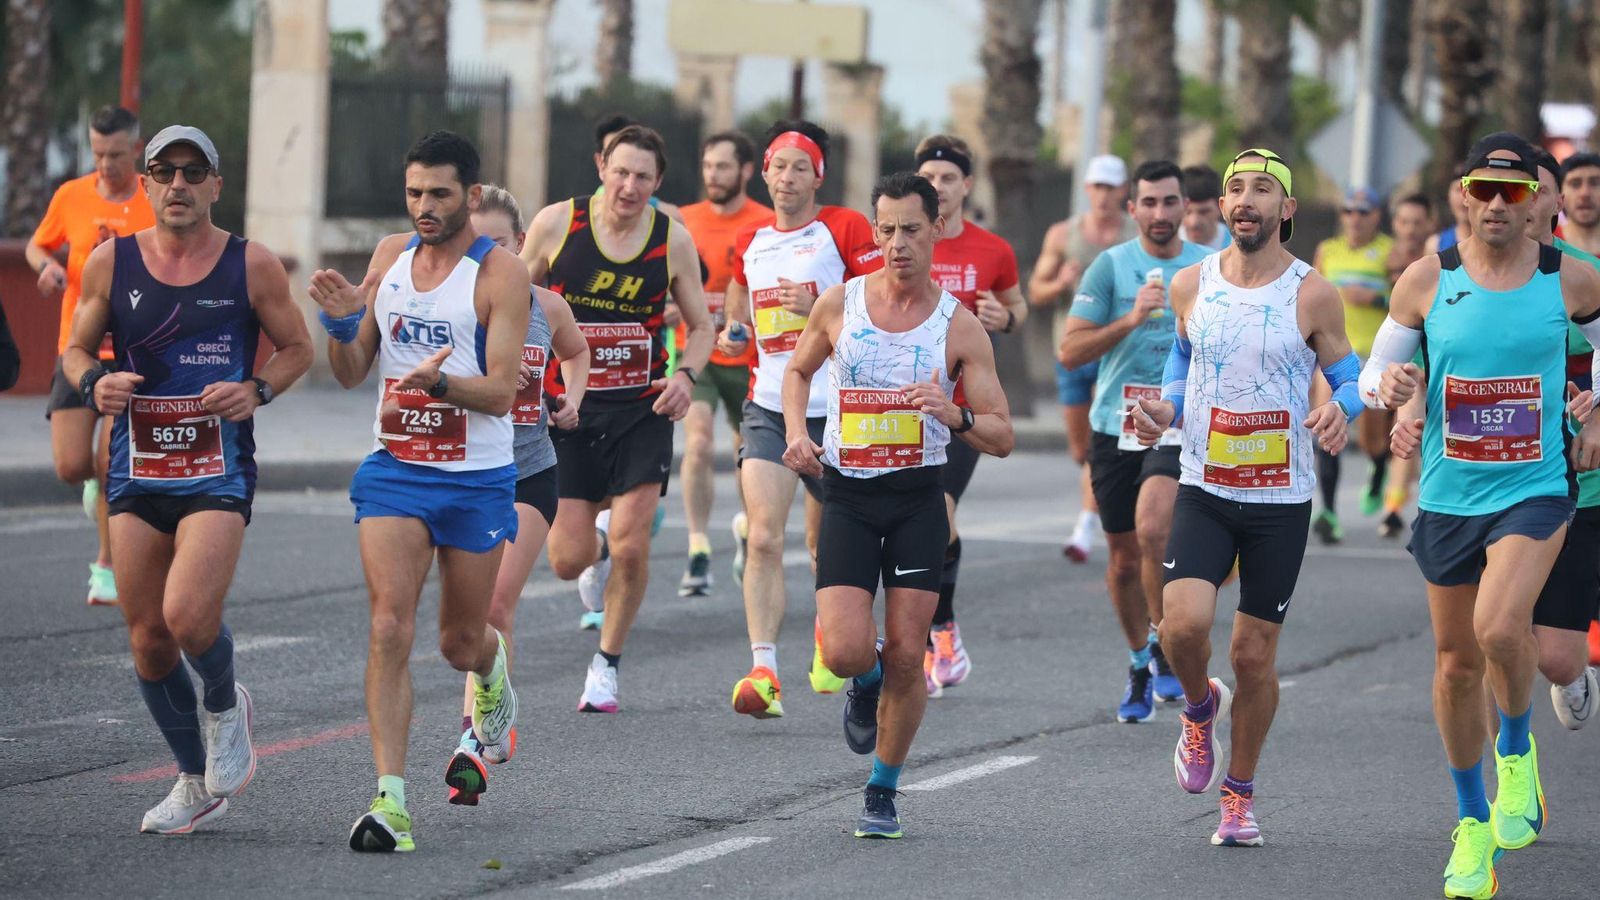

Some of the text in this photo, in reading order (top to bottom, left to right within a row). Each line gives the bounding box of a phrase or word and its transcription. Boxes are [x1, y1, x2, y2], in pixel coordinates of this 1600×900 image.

[856, 248, 883, 264] TICIN
[930, 263, 962, 272] NERALI
[565, 293, 653, 314] RACING CLUB
[596, 326, 645, 337] GENERALI
[179, 354, 230, 365] SALENTINA
[595, 347, 631, 361] 3995
[1469, 381, 1534, 395] GENERALI
[859, 392, 912, 405] GENERA
[151, 400, 205, 413] GENERA
[399, 409, 442, 427] 7243
[1228, 412, 1284, 427] GENERALI
[1470, 408, 1516, 425] 1537
[858, 418, 898, 433] 4141
[152, 426, 197, 442] 5679
[1226, 438, 1267, 454] 3909
